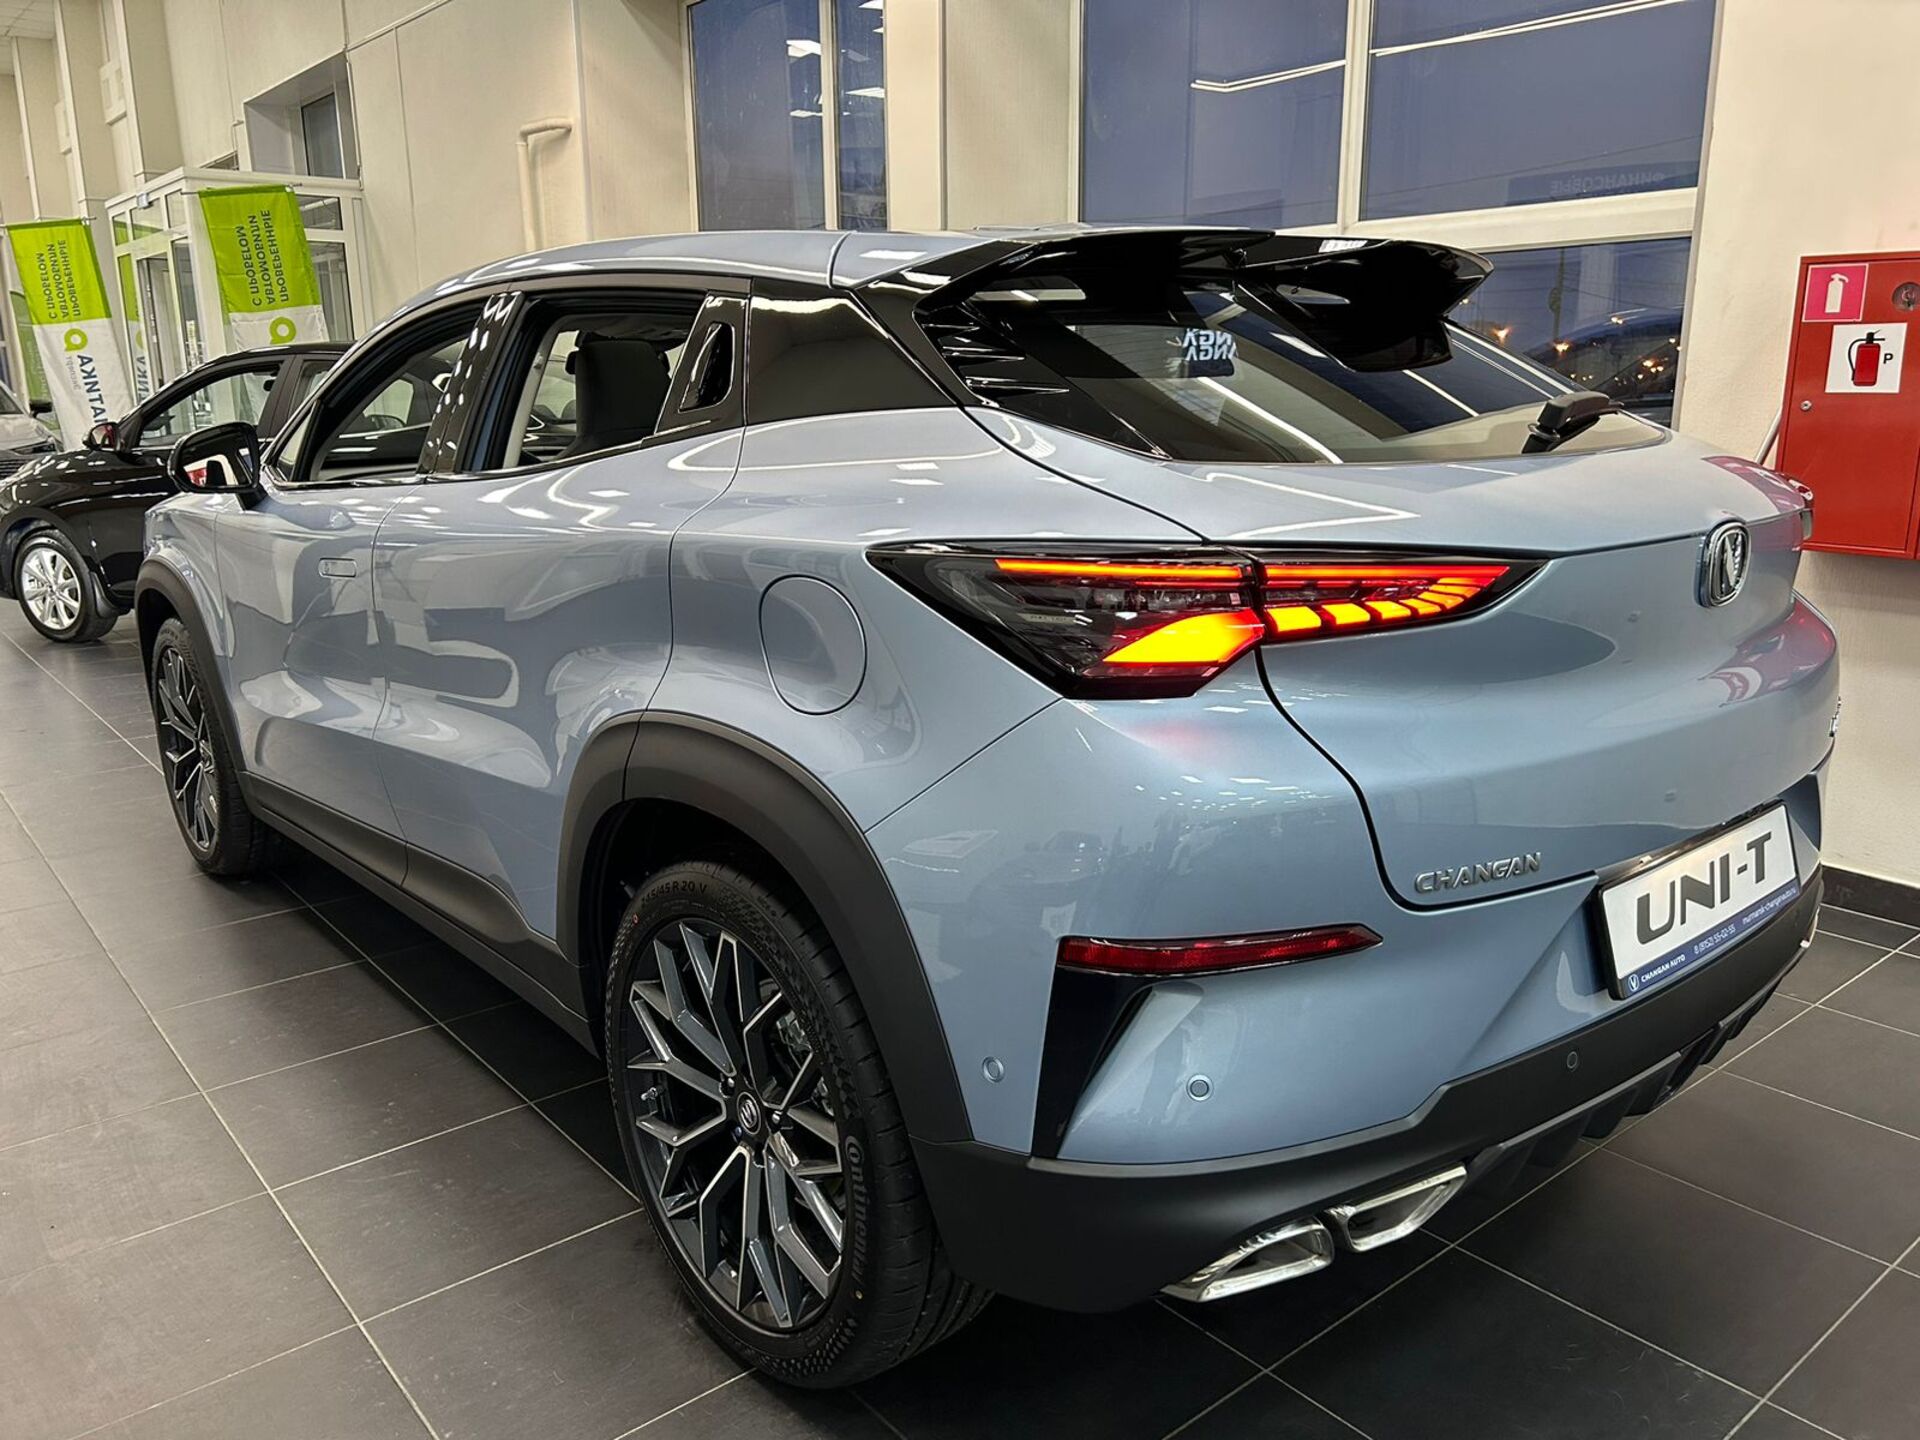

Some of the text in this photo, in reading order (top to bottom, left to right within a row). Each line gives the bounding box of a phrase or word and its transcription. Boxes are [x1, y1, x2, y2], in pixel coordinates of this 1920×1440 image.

[1883, 352, 1893, 364] P
[1415, 851, 1541, 895] CHANGAN
[1636, 831, 1772, 944] UNI-T
[1641, 962, 1670, 982] CHANGAN
[1670, 954, 1686, 967] AUTO
